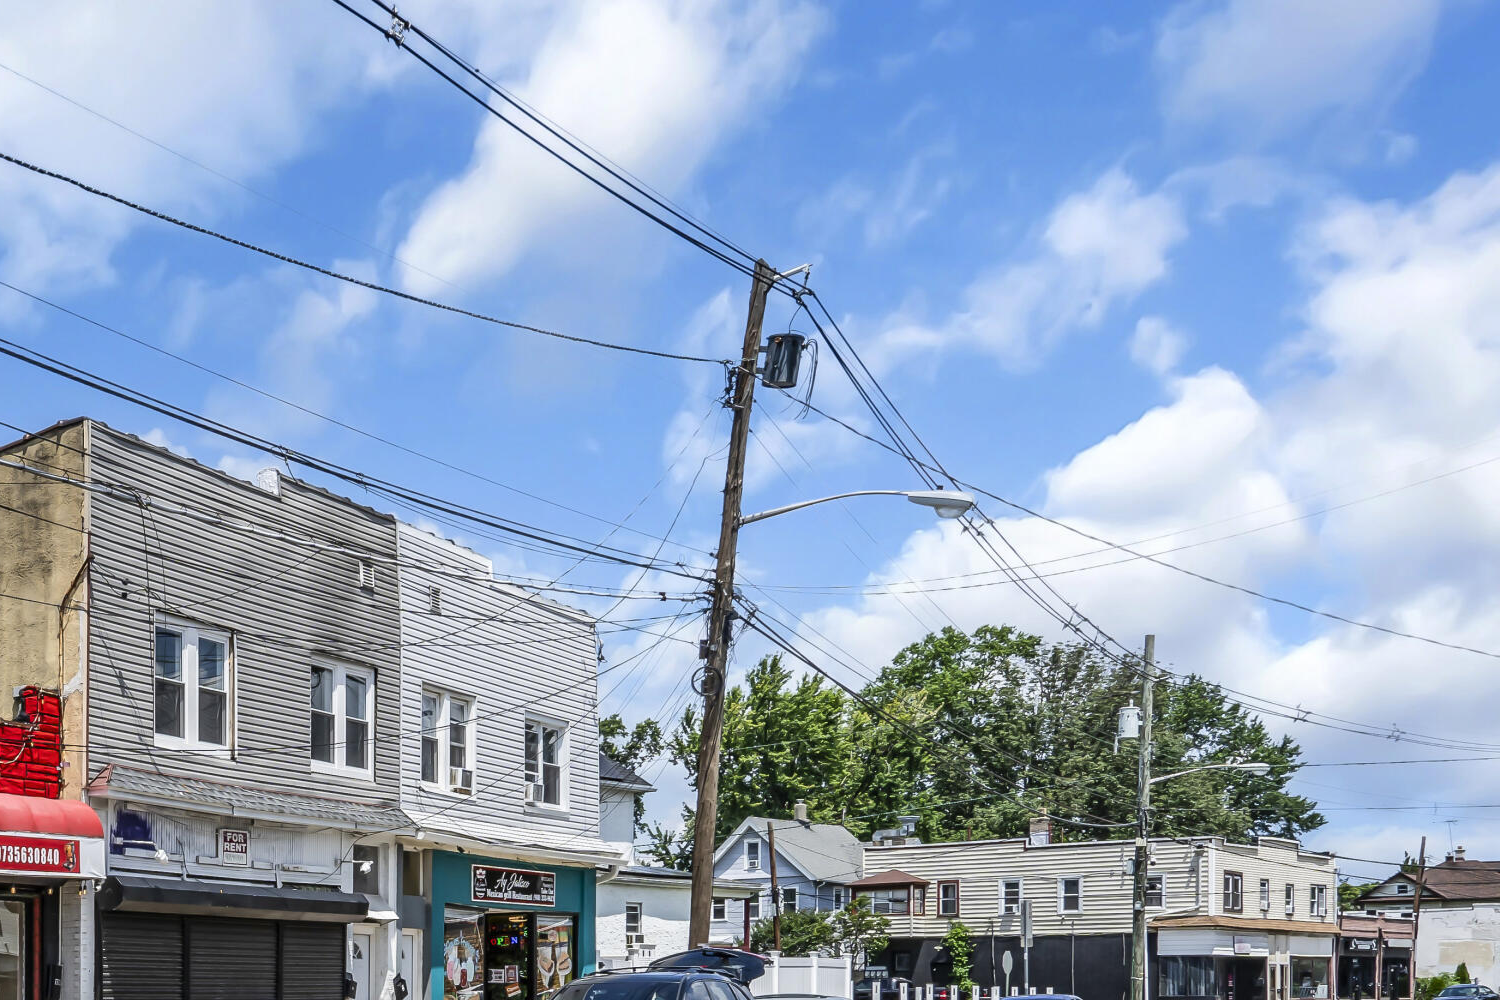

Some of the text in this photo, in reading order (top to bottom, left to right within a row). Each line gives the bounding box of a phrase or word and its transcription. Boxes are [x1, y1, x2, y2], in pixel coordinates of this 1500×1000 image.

[226, 832, 244, 843] FOR
[224, 842, 247, 852] RENT
[490, 936, 518, 946] OPEN
